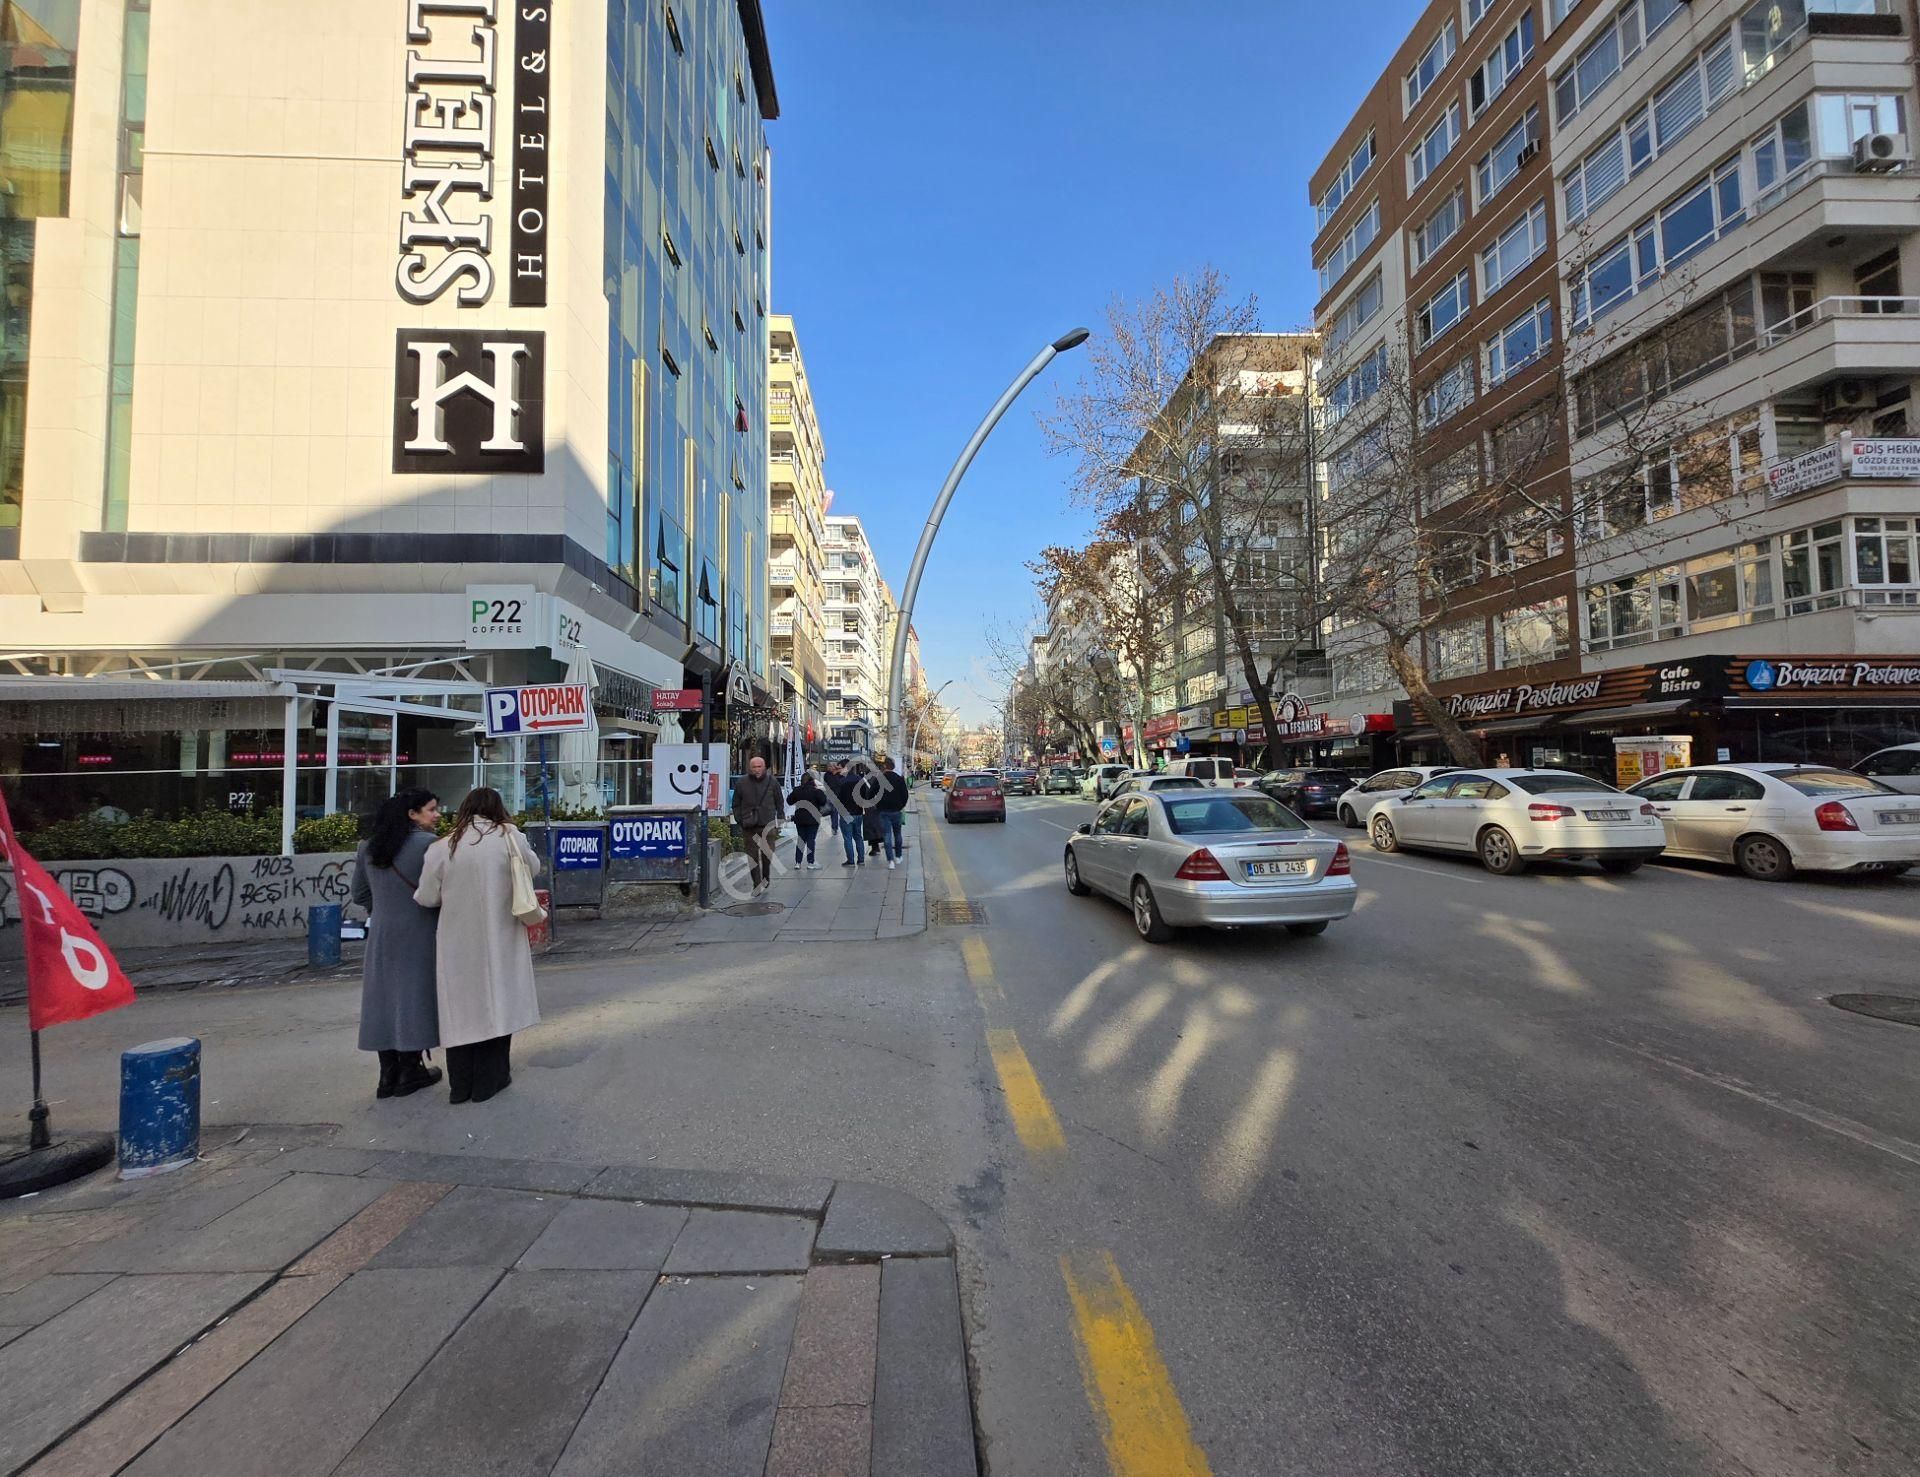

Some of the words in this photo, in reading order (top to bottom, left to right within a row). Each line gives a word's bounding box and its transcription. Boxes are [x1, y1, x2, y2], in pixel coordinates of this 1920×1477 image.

[521, 49, 546, 73] &
[517, 96, 546, 278] HOTEL
[472, 600, 522, 623] P22
[472, 625, 522, 633] COFFEE
[559, 614, 582, 643] P22
[1660, 667, 1690, 680] Cafe
[1776, 662, 1849, 688] Boğaziçi
[656, 692, 680, 700] HATAY
[1515, 675, 1602, 714] Pastanesi
[1661, 680, 1701, 693] Bistro
[489, 693, 516, 731] P
[520, 686, 586, 717] OTOPARK
[625, 706, 650, 725] COFFEE
[229, 792, 254, 804] P22
[613, 820, 682, 842] OTOPARK
[560, 837, 598, 854] OTOPARK
[251, 857, 294, 878] 1903
[1253, 863, 1265, 874] 06
[1269, 862, 1281, 873] EA
[1285, 861, 1306, 872] 2435
